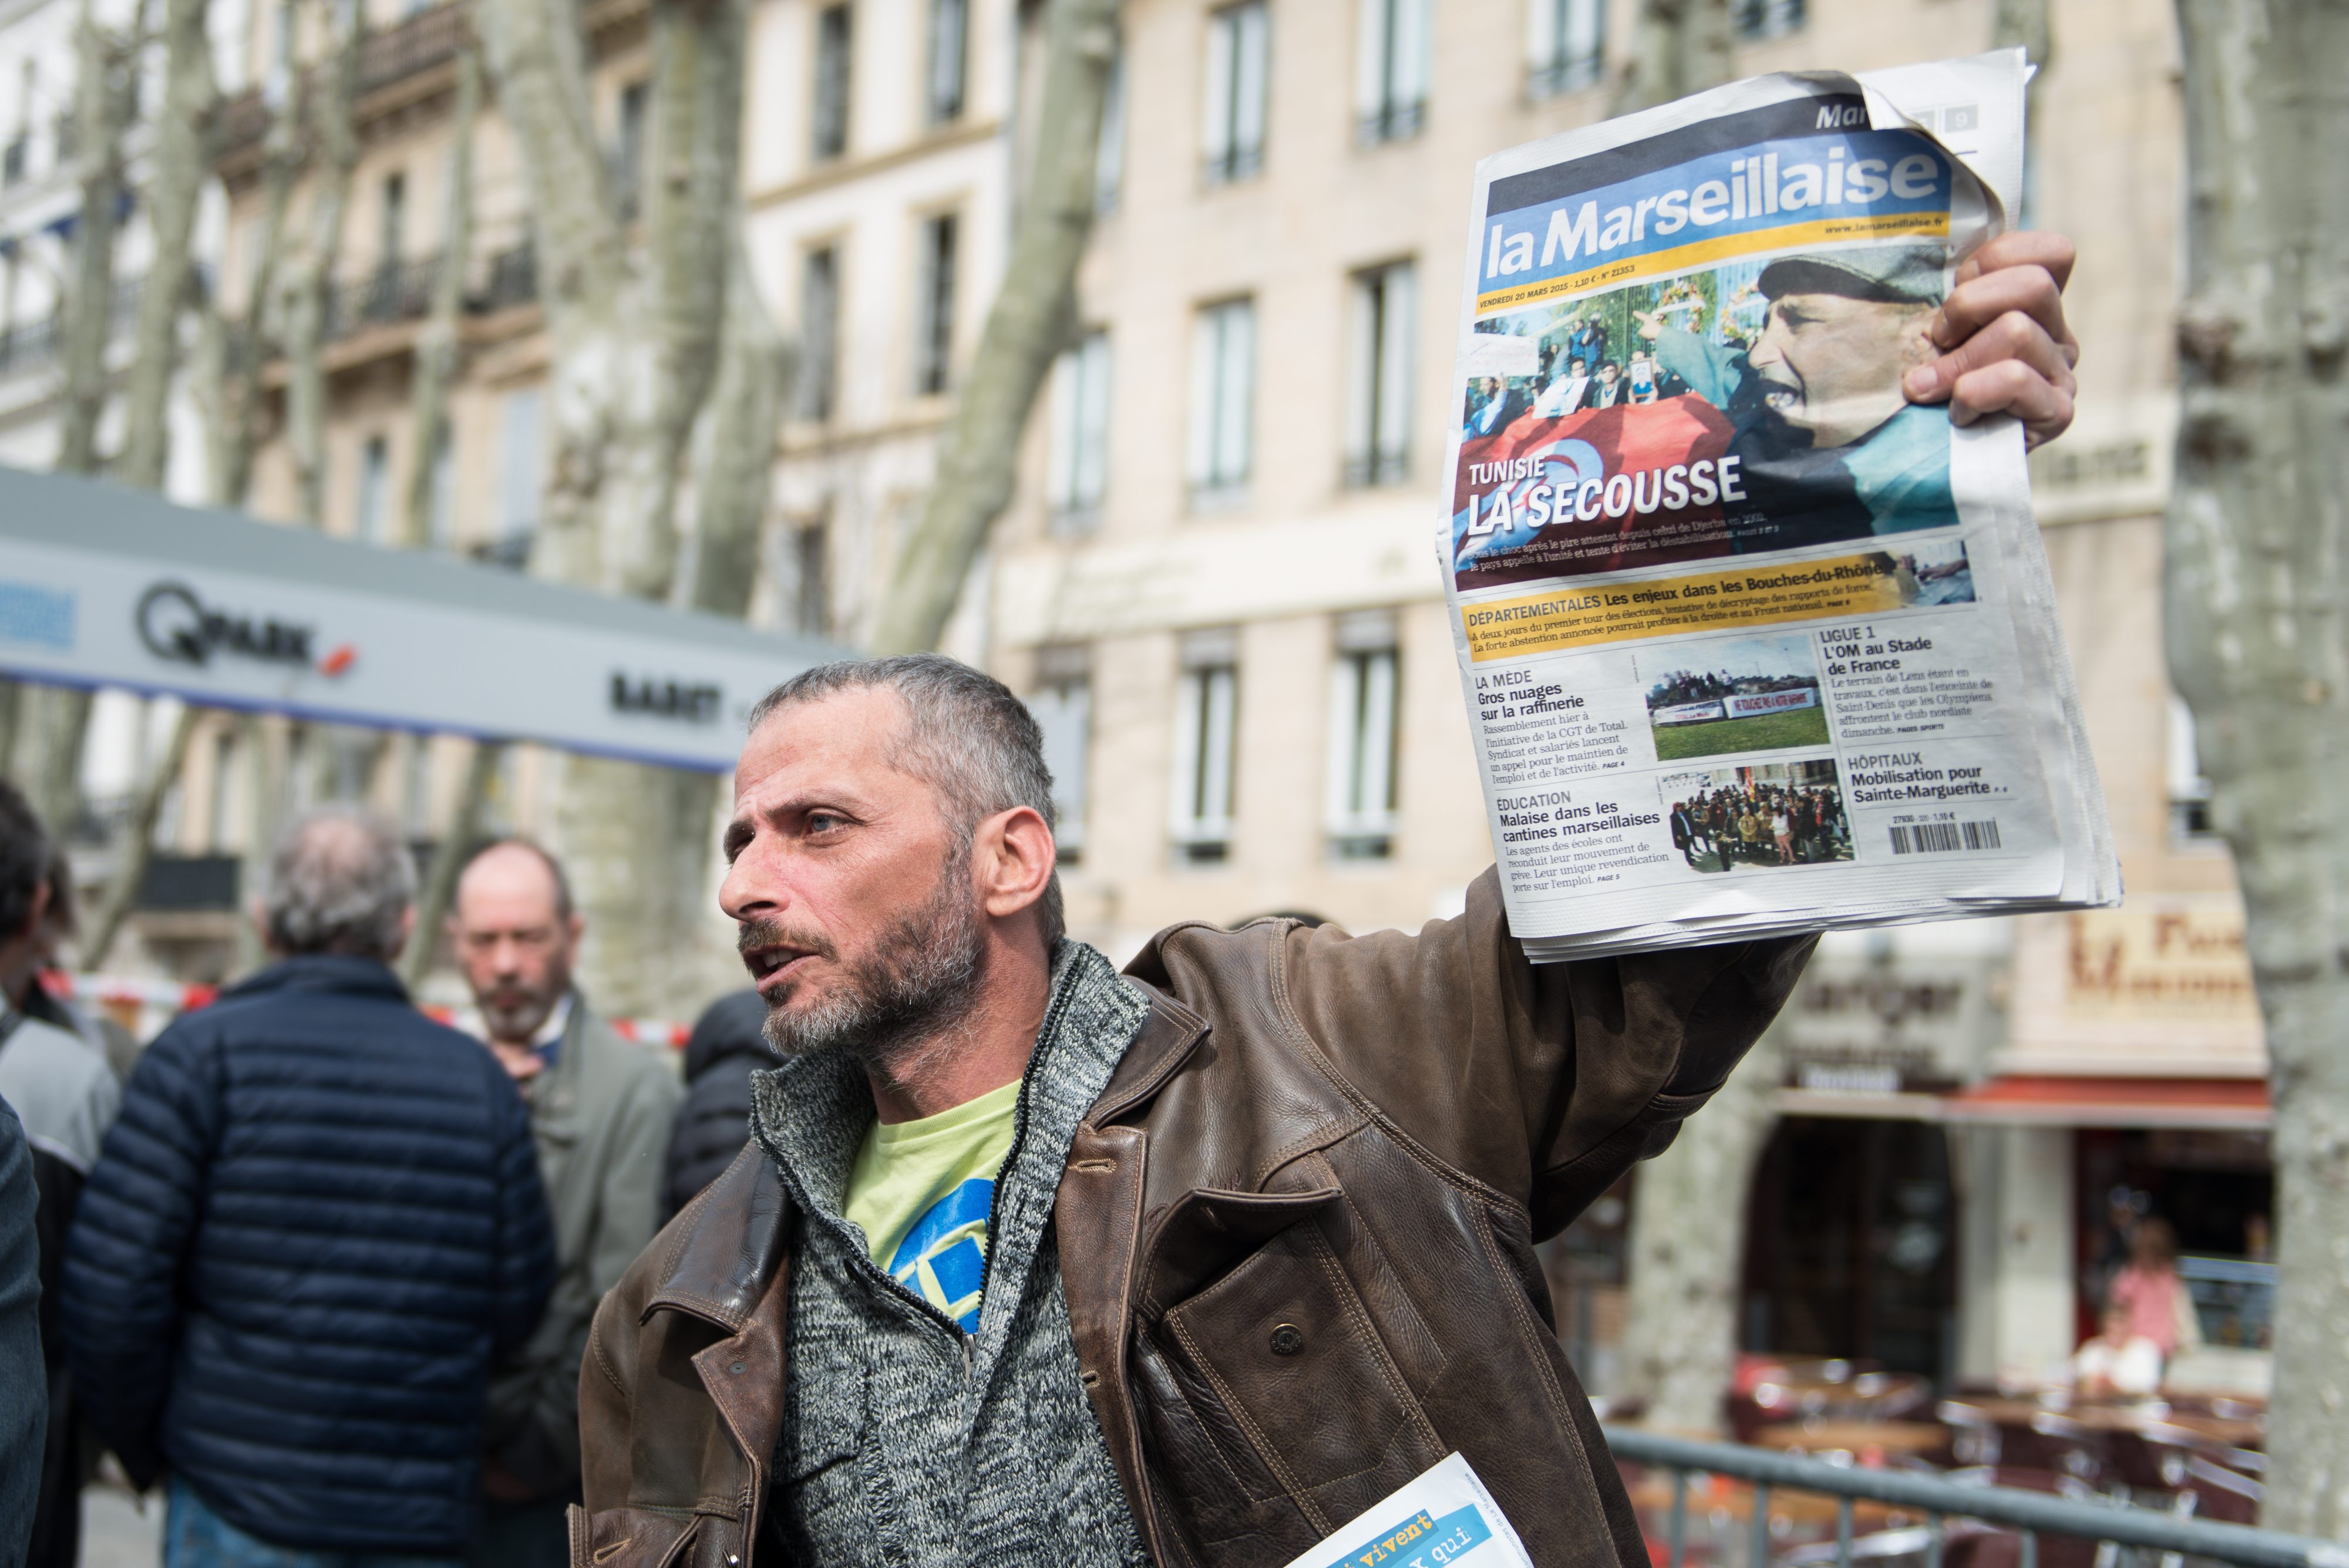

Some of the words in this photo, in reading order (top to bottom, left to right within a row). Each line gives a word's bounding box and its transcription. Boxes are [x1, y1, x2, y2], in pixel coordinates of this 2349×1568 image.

[1955, 112, 1968, 128] 9
[1486, 224, 1533, 279] la
[1539, 146, 1937, 268] Marseillaise
[1825, 218, 1944, 234] www.lamarseillaise.fr
[1480, 295, 1513, 308] VENDREDI
[1515, 292, 1525, 301] 20
[1527, 287, 1547, 298] MARS
[1550, 282, 1568, 292] 2015
[1575, 278, 1589, 288] 1,10
[1611, 265, 1635, 277] 21353
[1469, 455, 1546, 486] TUNISIE
[1468, 490, 1512, 536] LA
[1527, 455, 1747, 529] SECOUSSE
[1490, 547, 1499, 556] le
[1500, 546, 1521, 555] choc
[1523, 541, 1549, 554] après
[1550, 540, 1559, 549] le
[1560, 538, 1579, 550] pire
[1581, 533, 1618, 546] attentat
[1621, 529, 1651, 541] depuis
[1653, 524, 1677, 536] celui
[1678, 521, 1691, 532] de
[1691, 518, 1726, 531] Djerba
[1470, 562, 1478, 571] le
[1480, 560, 1502, 571] pays
[1503, 554, 1535, 567] appelle
[1536, 553, 1542, 563] à
[1544, 550, 1573, 562] l'unité
[1574, 550, 1584, 558] et
[1586, 546, 1610, 556] tente
[1611, 541, 1647, 553] d'éviter
[1649, 539, 1658, 548] la
[1469, 595, 1601, 626] DÉPARTEMENTALES
[1604, 594, 1628, 606] Les
[1633, 588, 1679, 603] enjeux
[1683, 584, 1717, 597] dans
[1721, 580, 1743, 593] les
[1746, 563, 1883, 590] Bouches-du-Rhône
[1480, 629, 1501, 640] deux
[1503, 626, 1527, 638] jours
[1530, 624, 1542, 632] du
[1544, 618, 1581, 631] premier
[1583, 615, 1603, 624] tour
[1606, 611, 1621, 621] des
[1622, 607, 1664, 618] élections,
[1665, 603, 1705, 613] tentative
[1707, 600, 1717, 610] de
[1719, 595, 1769, 610] décryptage
[1771, 593, 1788, 602] des
[1789, 588, 1830, 601] rapports
[1832, 586, 1844, 594] de
[1474, 644, 1484, 652] La
[1486, 639, 1507, 650] forte
[1509, 632, 1558, 647] abstention
[1560, 627, 1604, 640] annoncée
[1607, 620, 1644, 634] pourrait
[1647, 617, 1680, 628] profiter
[1701, 611, 1728, 621] droite
[1755, 606, 1781, 616] Front
[1820, 628, 1862, 643] LIGUE
[1867, 626, 1876, 638] 1
[1825, 644, 1860, 659] L'OM
[1866, 643, 1884, 655] au
[1888, 637, 1933, 652] Stade
[1829, 662, 1847, 675] de
[1851, 658, 1900, 673] France
[1831, 678, 1845, 688] Le
[1847, 674, 1883, 686] terrain
[1886, 671, 1898, 682] de
[1900, 671, 1926, 681] Lens
[1957, 668, 1969, 677] en
[1475, 677, 1489, 689] LA
[1493, 670, 1532, 687] MÈDE
[1834, 690, 1877, 700] travaux,
[1879, 687, 1900, 696] c'est
[1903, 684, 1928, 694] dans
[1980, 679, 1993, 688] de
[1479, 693, 1505, 705] Gros
[1510, 685, 1562, 700] nuages
[1836, 701, 1896, 713] Saint-Denis
[1899, 699, 1917, 709] que
[1920, 695, 1934, 705] les
[1482, 710, 1498, 721] sur
[1503, 705, 1515, 718] la
[1520, 696, 1584, 716] raffinerie
[1893, 711, 1902, 721] le
[1903, 708, 1927, 719] club
[1483, 716, 1556, 734] Rassemblement
[1559, 714, 1580, 724] hier
[1583, 711, 1590, 721] à
[1486, 735, 1530, 748] l'initiative
[1533, 731, 1544, 741] de
[1547, 731, 1556, 739] la
[1559, 726, 1583, 738] CGT
[1586, 725, 1597, 734] de
[1599, 721, 1628, 732] Total.
[1488, 748, 1525, 761] Syndicat
[1540, 741, 1579, 753] salariés
[1582, 734, 1620, 747] lancent
[1502, 760, 1526, 773] appel
[1529, 757, 1553, 769] pour
[1556, 755, 1564, 763] le
[1567, 748, 1614, 762] maintien
[1616, 746, 1628, 755] de
[1847, 752, 1923, 769] HÔPITAUX
[1492, 772, 1525, 784] l'emploi
[1539, 768, 1551, 778] de
[1553, 762, 1600, 776] l'activité.
[1852, 768, 1943, 786] Mobilisation
[1948, 767, 1982, 781] pour
[1497, 791, 1571, 811] ÉDUCATION
[1855, 782, 1991, 802] Sainte-Marguerite
[1500, 812, 1549, 827] Malaise
[1555, 806, 1590, 820] dans
[1596, 802, 1618, 815] les
[1503, 827, 1557, 842] cantines
[1563, 813, 1660, 836] marseillaises
[1506, 847, 1517, 856] Les
[1520, 843, 1550, 856] agents
[1552, 841, 1569, 851] des
[1572, 837, 1603, 849] écoles
[1606, 834, 1623, 843] ont
[1508, 857, 1548, 868] reconduit
[1550, 854, 1571, 864] leur
[1574, 845, 1635, 861] mouvement
[1638, 842, 1650, 852] de
[1511, 871, 1532, 881] grève.
[1534, 867, 1557, 878] Leur
[1560, 863, 1596, 878] unique
[1598, 853, 1669, 870] revendication
[1513, 883, 1532, 893] porte
[1552, 876, 1594, 889] l'emploi.
[1464, 1472, 1490, 1509] Marseillaise
[1495, 1517, 1503, 1527] de
[1359, 1514, 1432, 1567] vivent
[1432, 1526, 1472, 1563] qui
